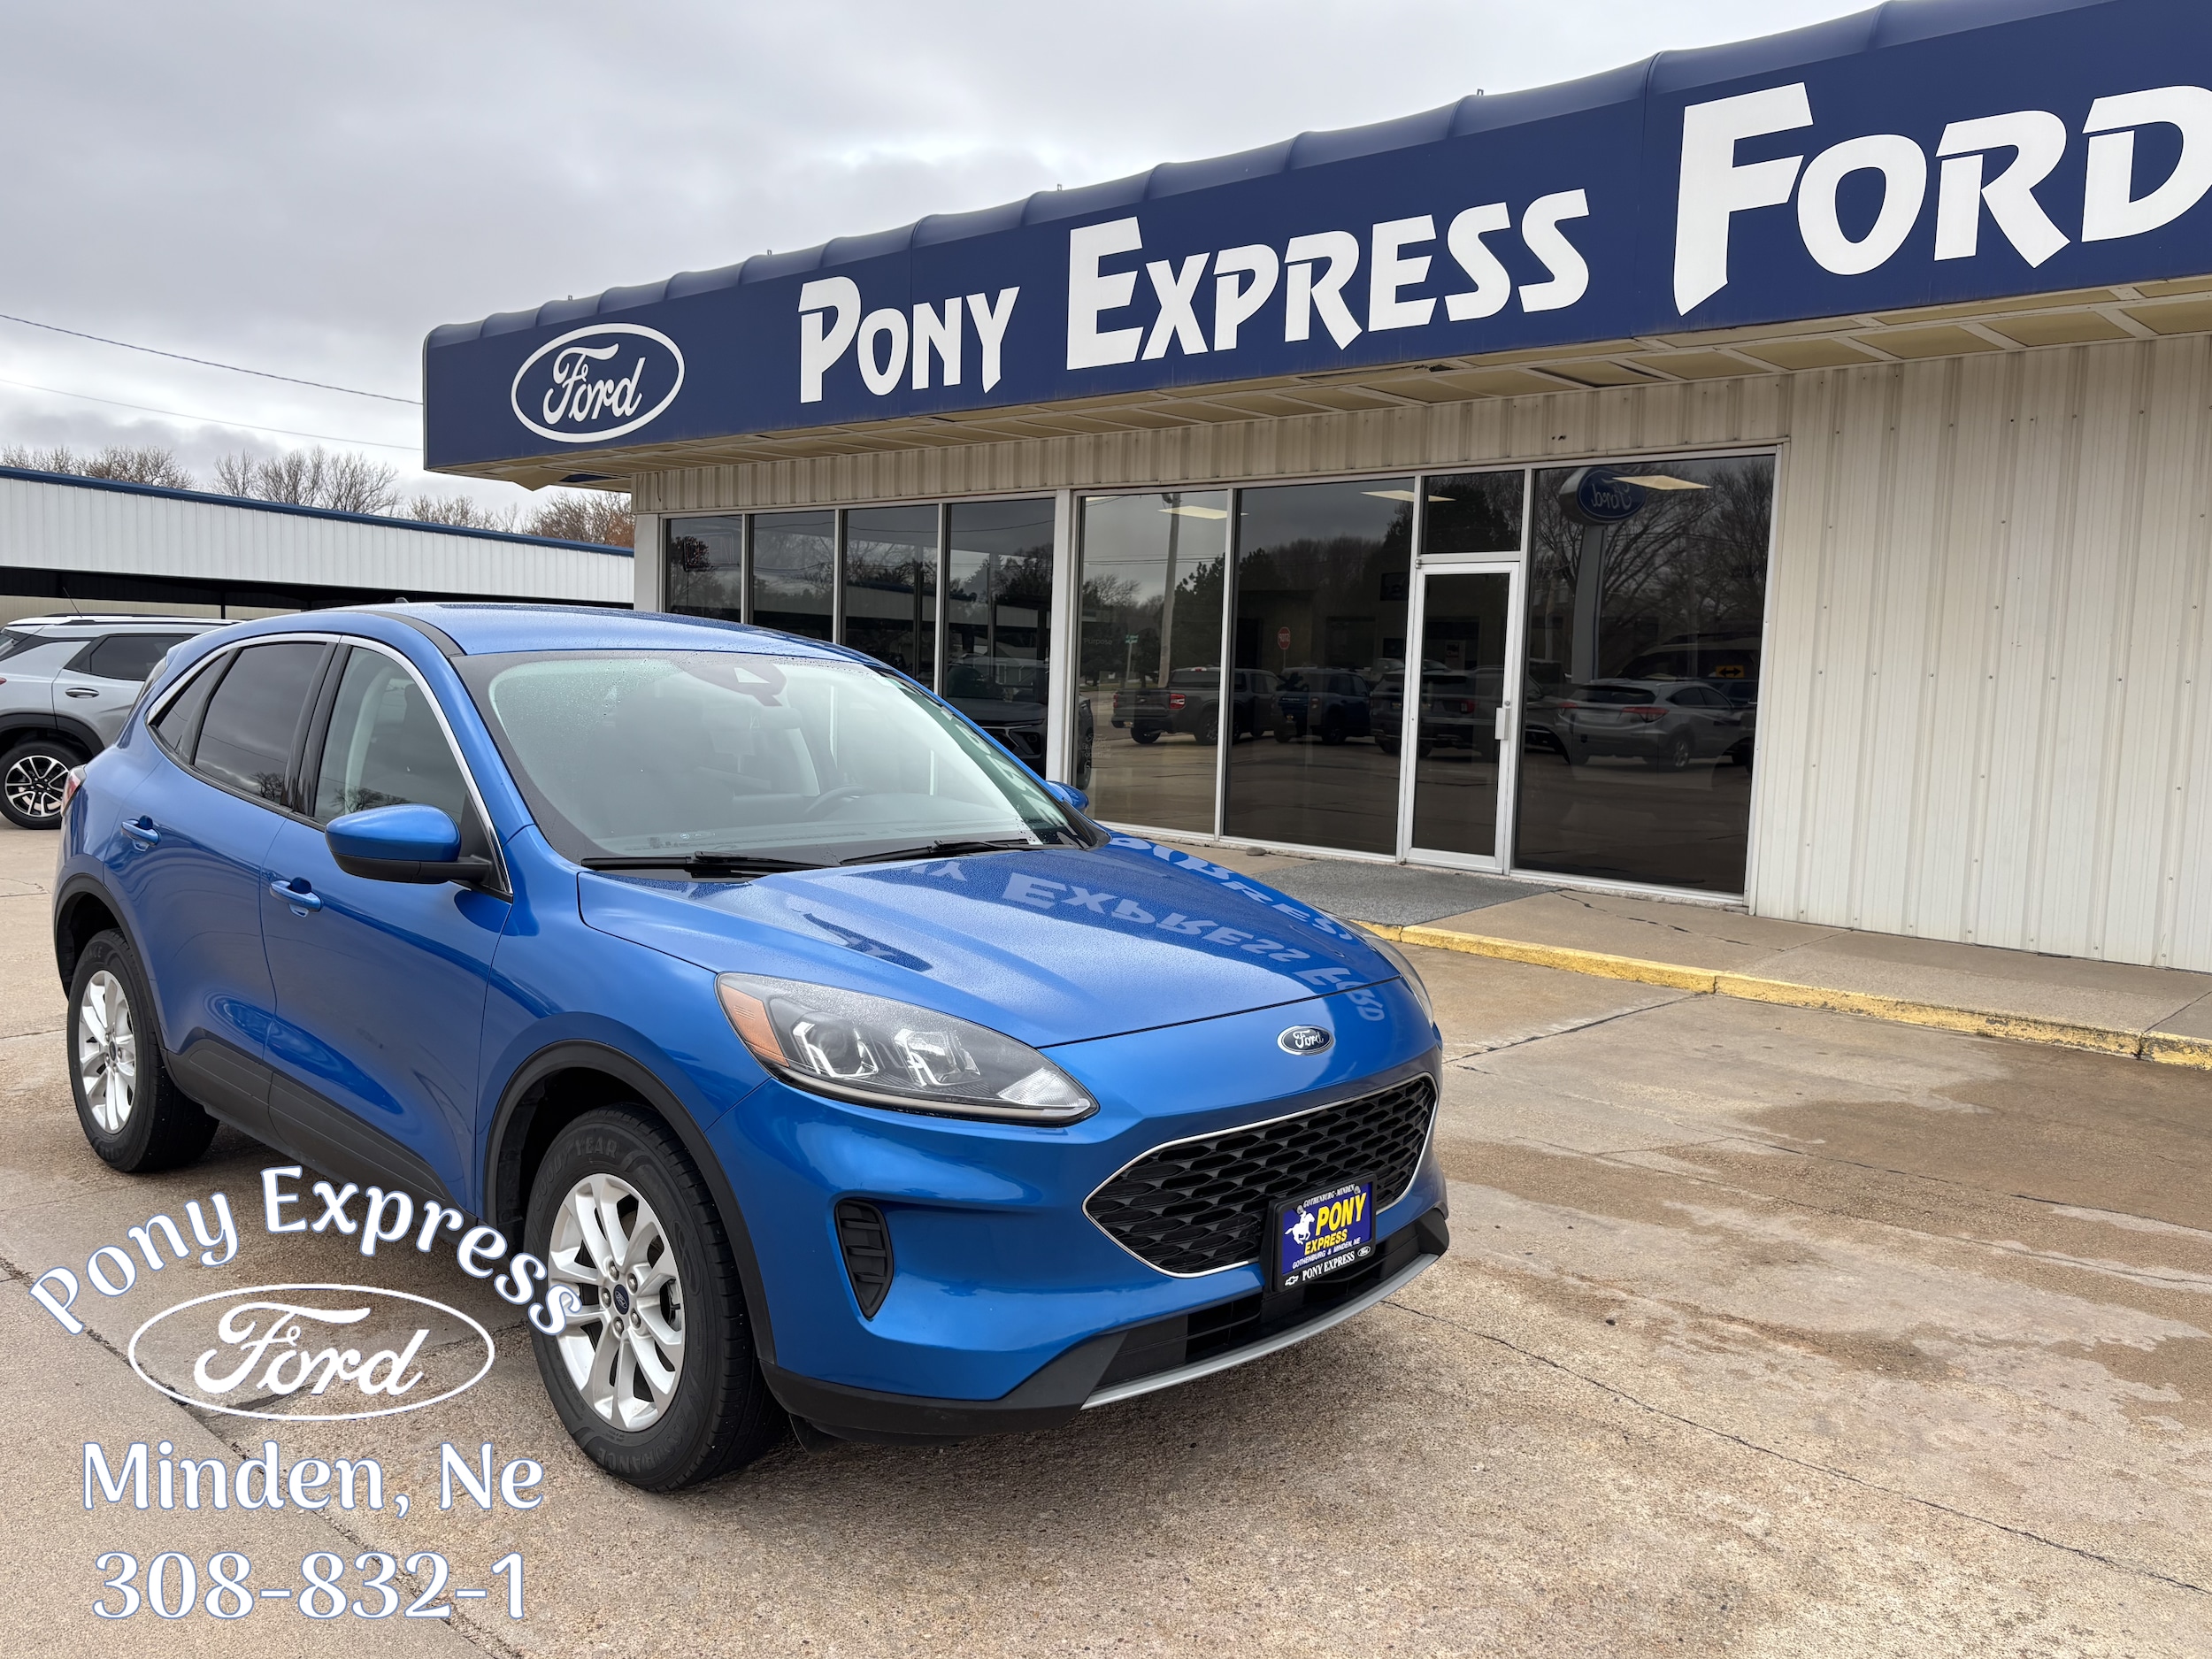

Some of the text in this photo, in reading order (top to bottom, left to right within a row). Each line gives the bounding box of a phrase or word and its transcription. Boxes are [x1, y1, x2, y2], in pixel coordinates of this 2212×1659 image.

[798, 82, 2212, 404] PONY EXPRESS FORD
[542, 342, 646, 425] Ford
[1315, 1192, 1367, 1236] PONY
[1292, 1249, 1326, 1270] GOTHENBURG
[1304, 1228, 1348, 1256] EXPRESS
[1302, 1250, 1356, 1281] PONY EXPRESS
